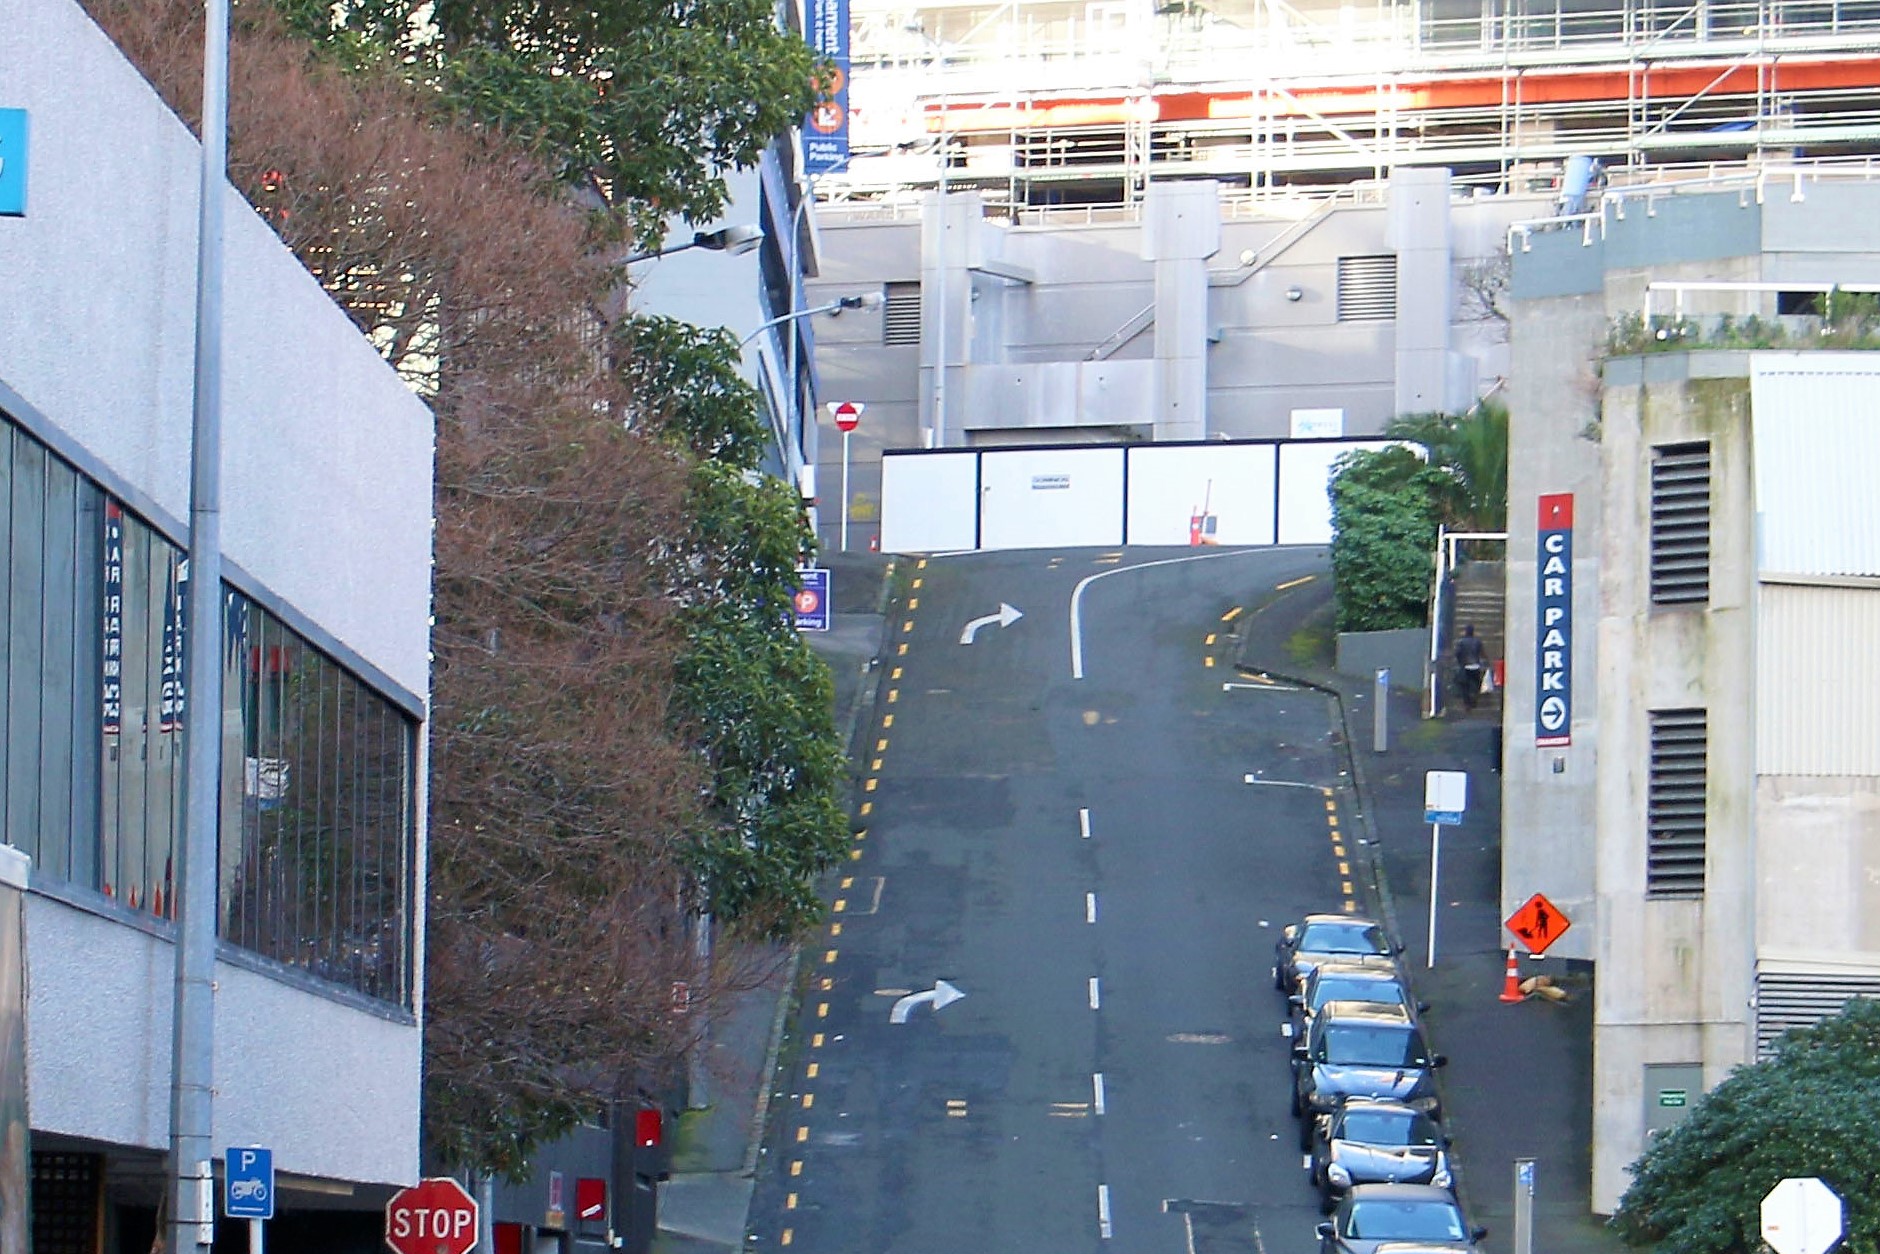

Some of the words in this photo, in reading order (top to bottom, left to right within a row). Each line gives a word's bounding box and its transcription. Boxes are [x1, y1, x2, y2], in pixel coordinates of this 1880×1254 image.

[825, 0, 840, 54] ament
[1543, 534, 1566, 596] CAR
[795, 619, 822, 628] arking
[1542, 607, 1565, 691] PARK
[241, 1151, 256, 1171] P
[393, 1208, 472, 1239] STOP
